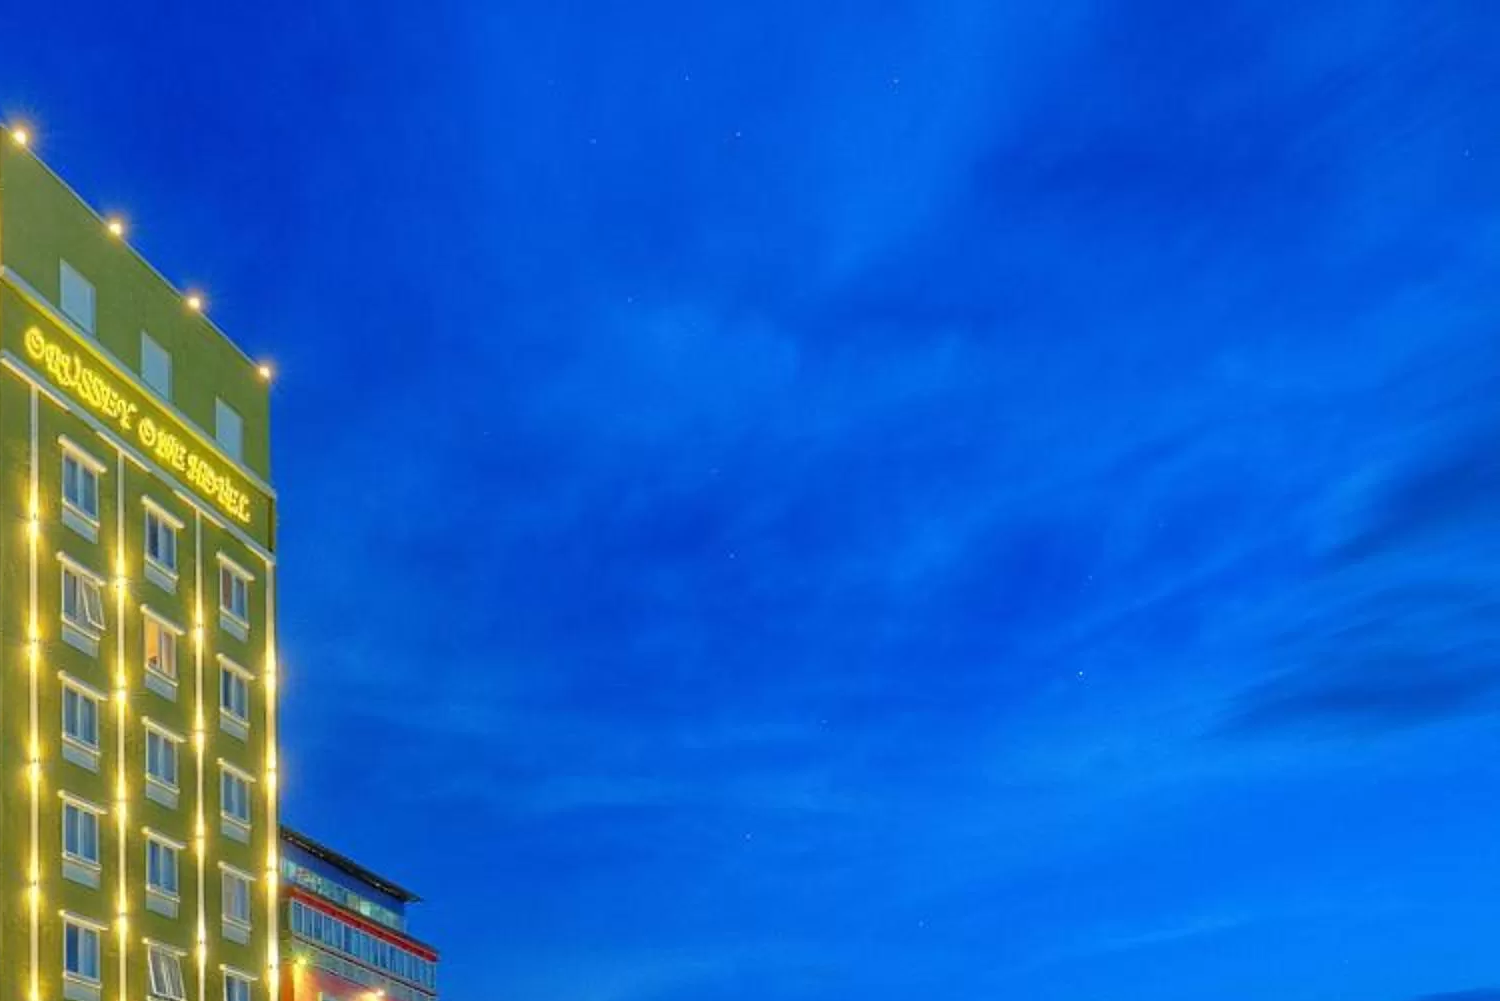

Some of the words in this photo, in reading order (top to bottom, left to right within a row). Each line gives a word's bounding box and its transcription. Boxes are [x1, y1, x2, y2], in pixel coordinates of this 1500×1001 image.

[24, 326, 137, 430] ORUSSEY
[138, 416, 187, 472] ONE
[186, 453, 251, 523] HOTEL
